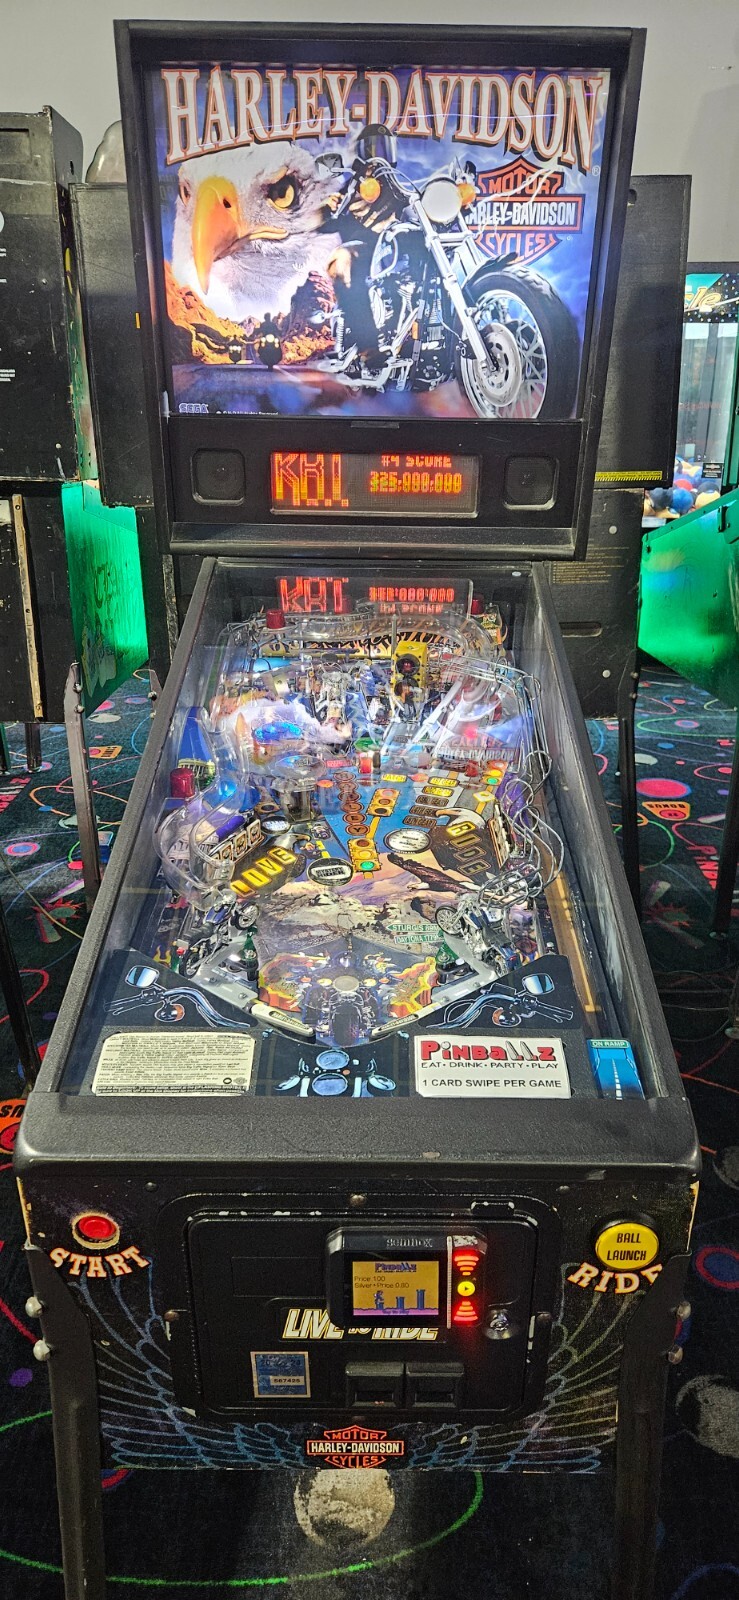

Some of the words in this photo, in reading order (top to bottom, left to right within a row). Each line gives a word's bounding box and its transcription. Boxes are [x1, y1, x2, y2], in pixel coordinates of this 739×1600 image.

[161, 66, 603, 171] HARLEY-DAVIDSON
[489, 167, 550, 195] MOTOR
[486, 232, 545, 260] CYCLES
[179, 403, 209, 413] SEGA
[604, 1040, 627, 1048] RAMP
[423, 1079, 427, 1087] 1
[431, 1079, 463, 1087] CARD
[465, 1079, 500, 1088] SWIPE
[503, 1080, 526, 1088] PER
[529, 1080, 562, 1088] GAME
[616, 1233, 642, 1243] BALL
[49, 1244, 151, 1278] START
[606, 1250, 647, 1261] LAUNCH
[332, 1428, 379, 1440] MOTOR
[311, 1442, 400, 1453] HARLEY-DAVIDSON
[332, 1455, 379, 1468] CYCLES
